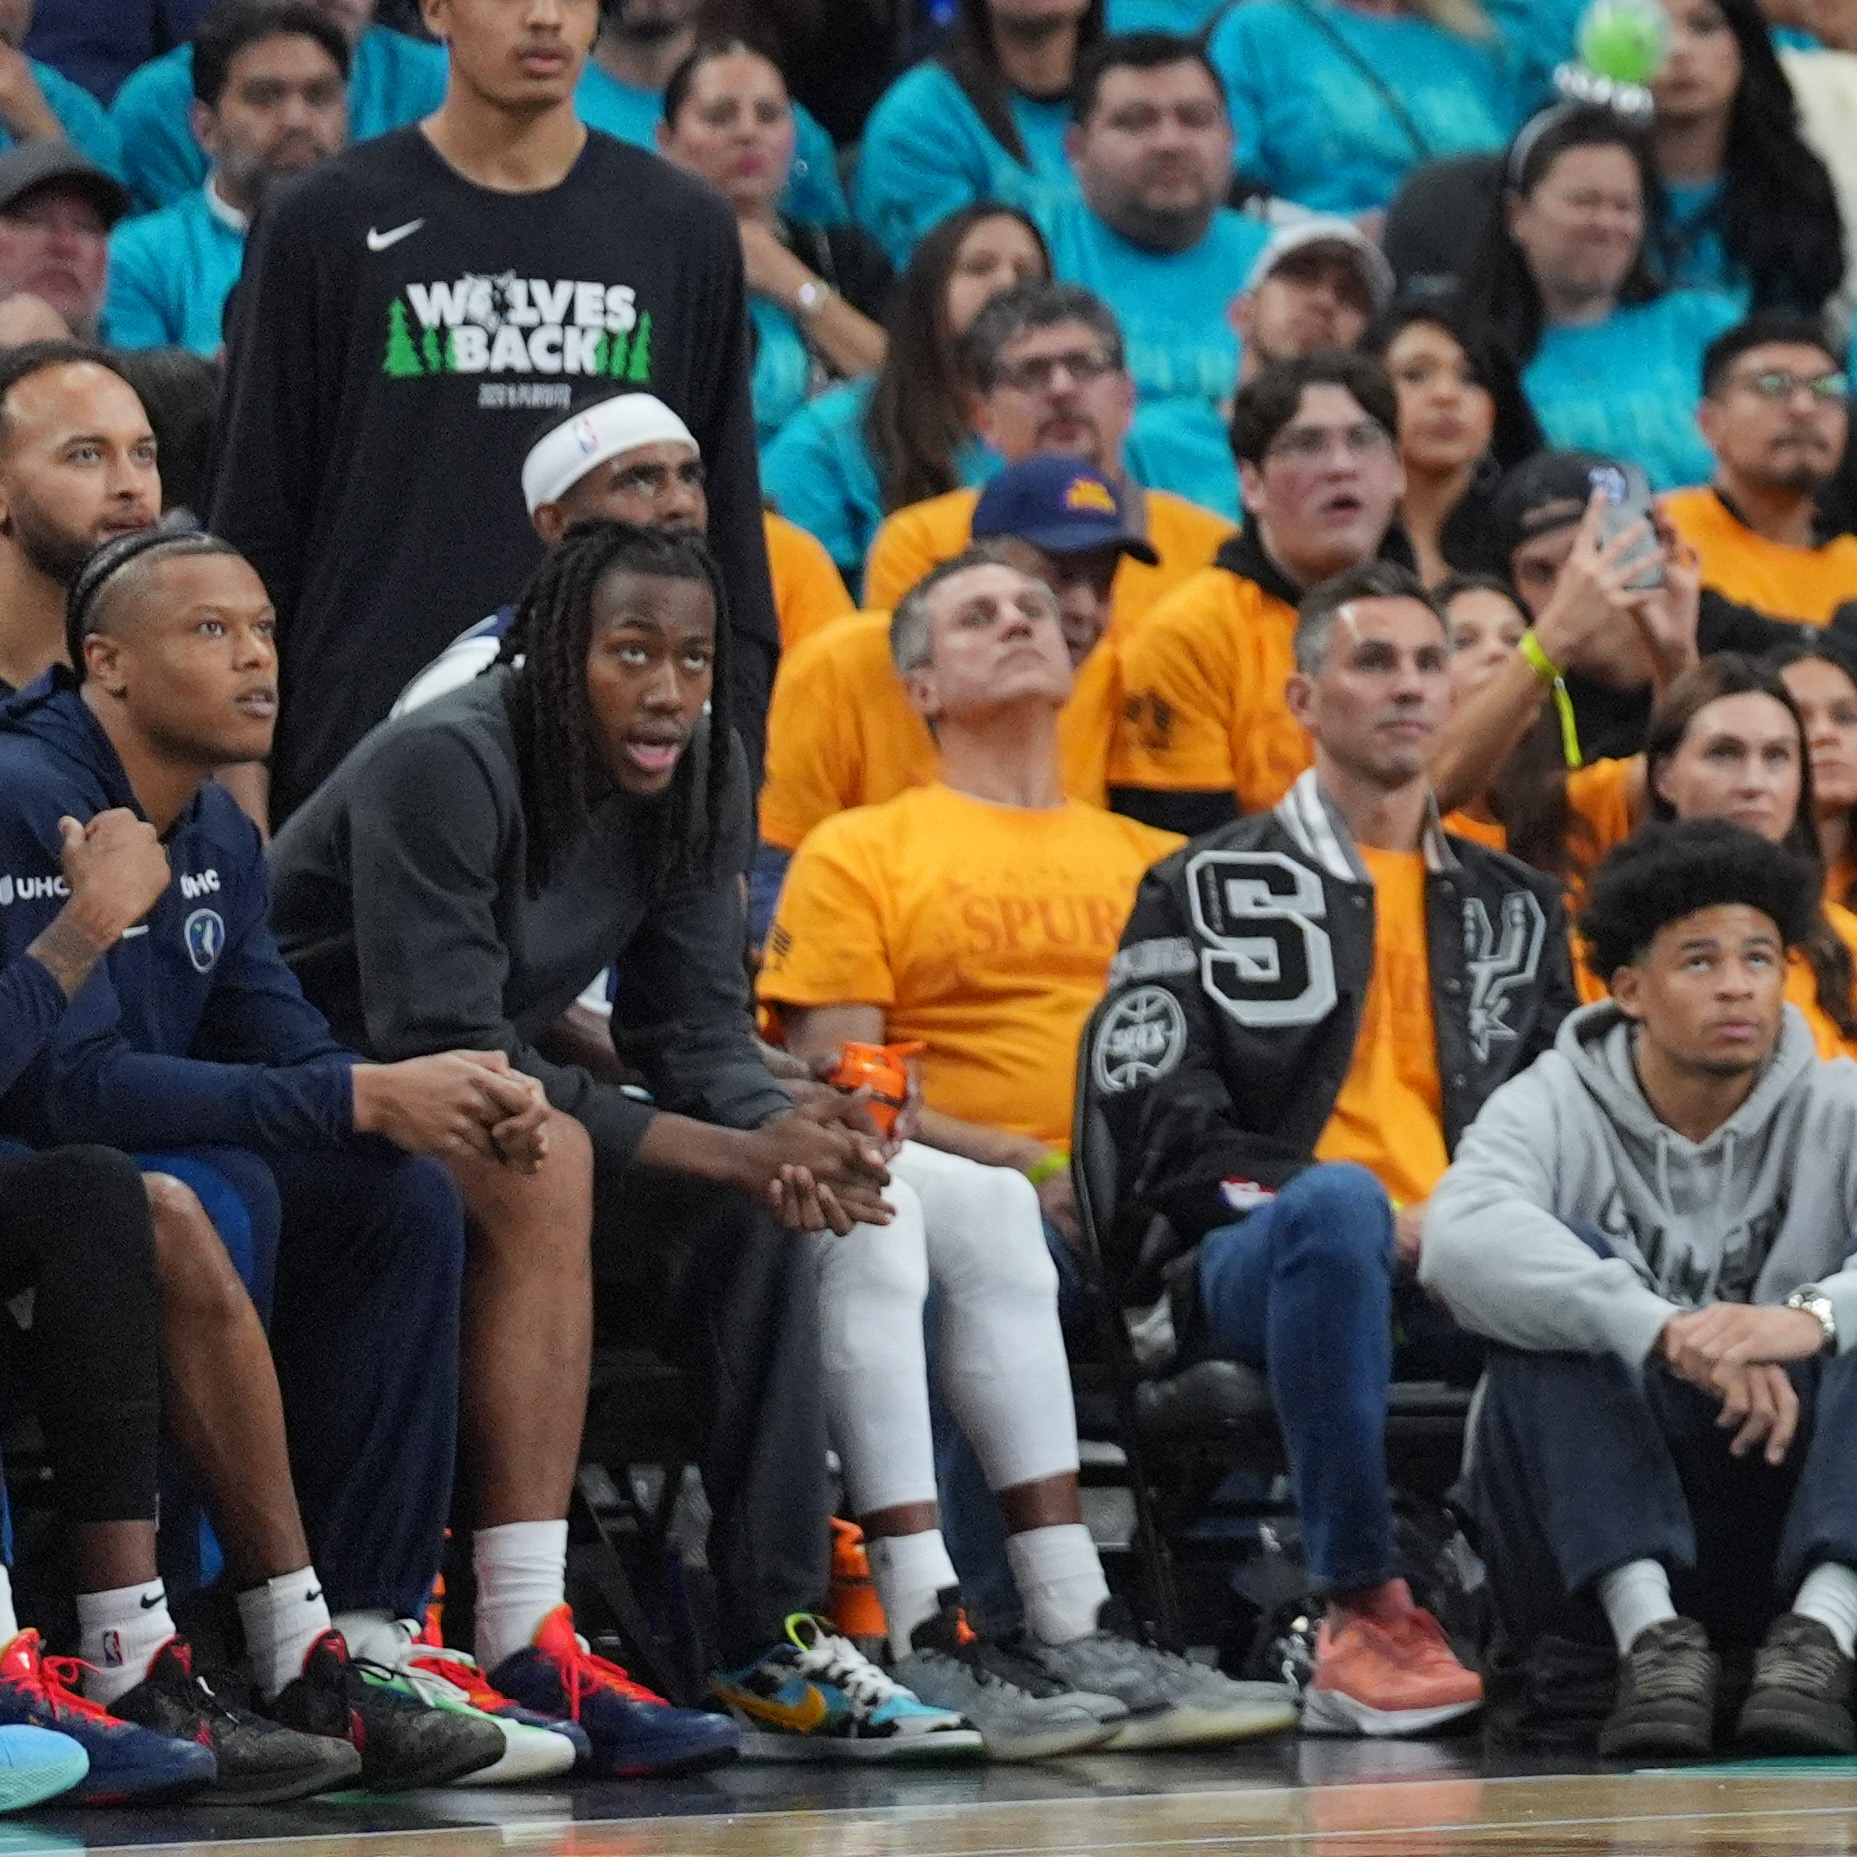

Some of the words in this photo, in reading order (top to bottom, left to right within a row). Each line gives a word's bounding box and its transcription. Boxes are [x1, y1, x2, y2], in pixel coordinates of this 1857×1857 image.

[452, 324, 602, 376] BACK
[16, 874, 71, 900] UHC
[180, 868, 221, 899] UHC
[961, 894, 1122, 947] SPUR
[1185, 849, 1338, 1028] S
